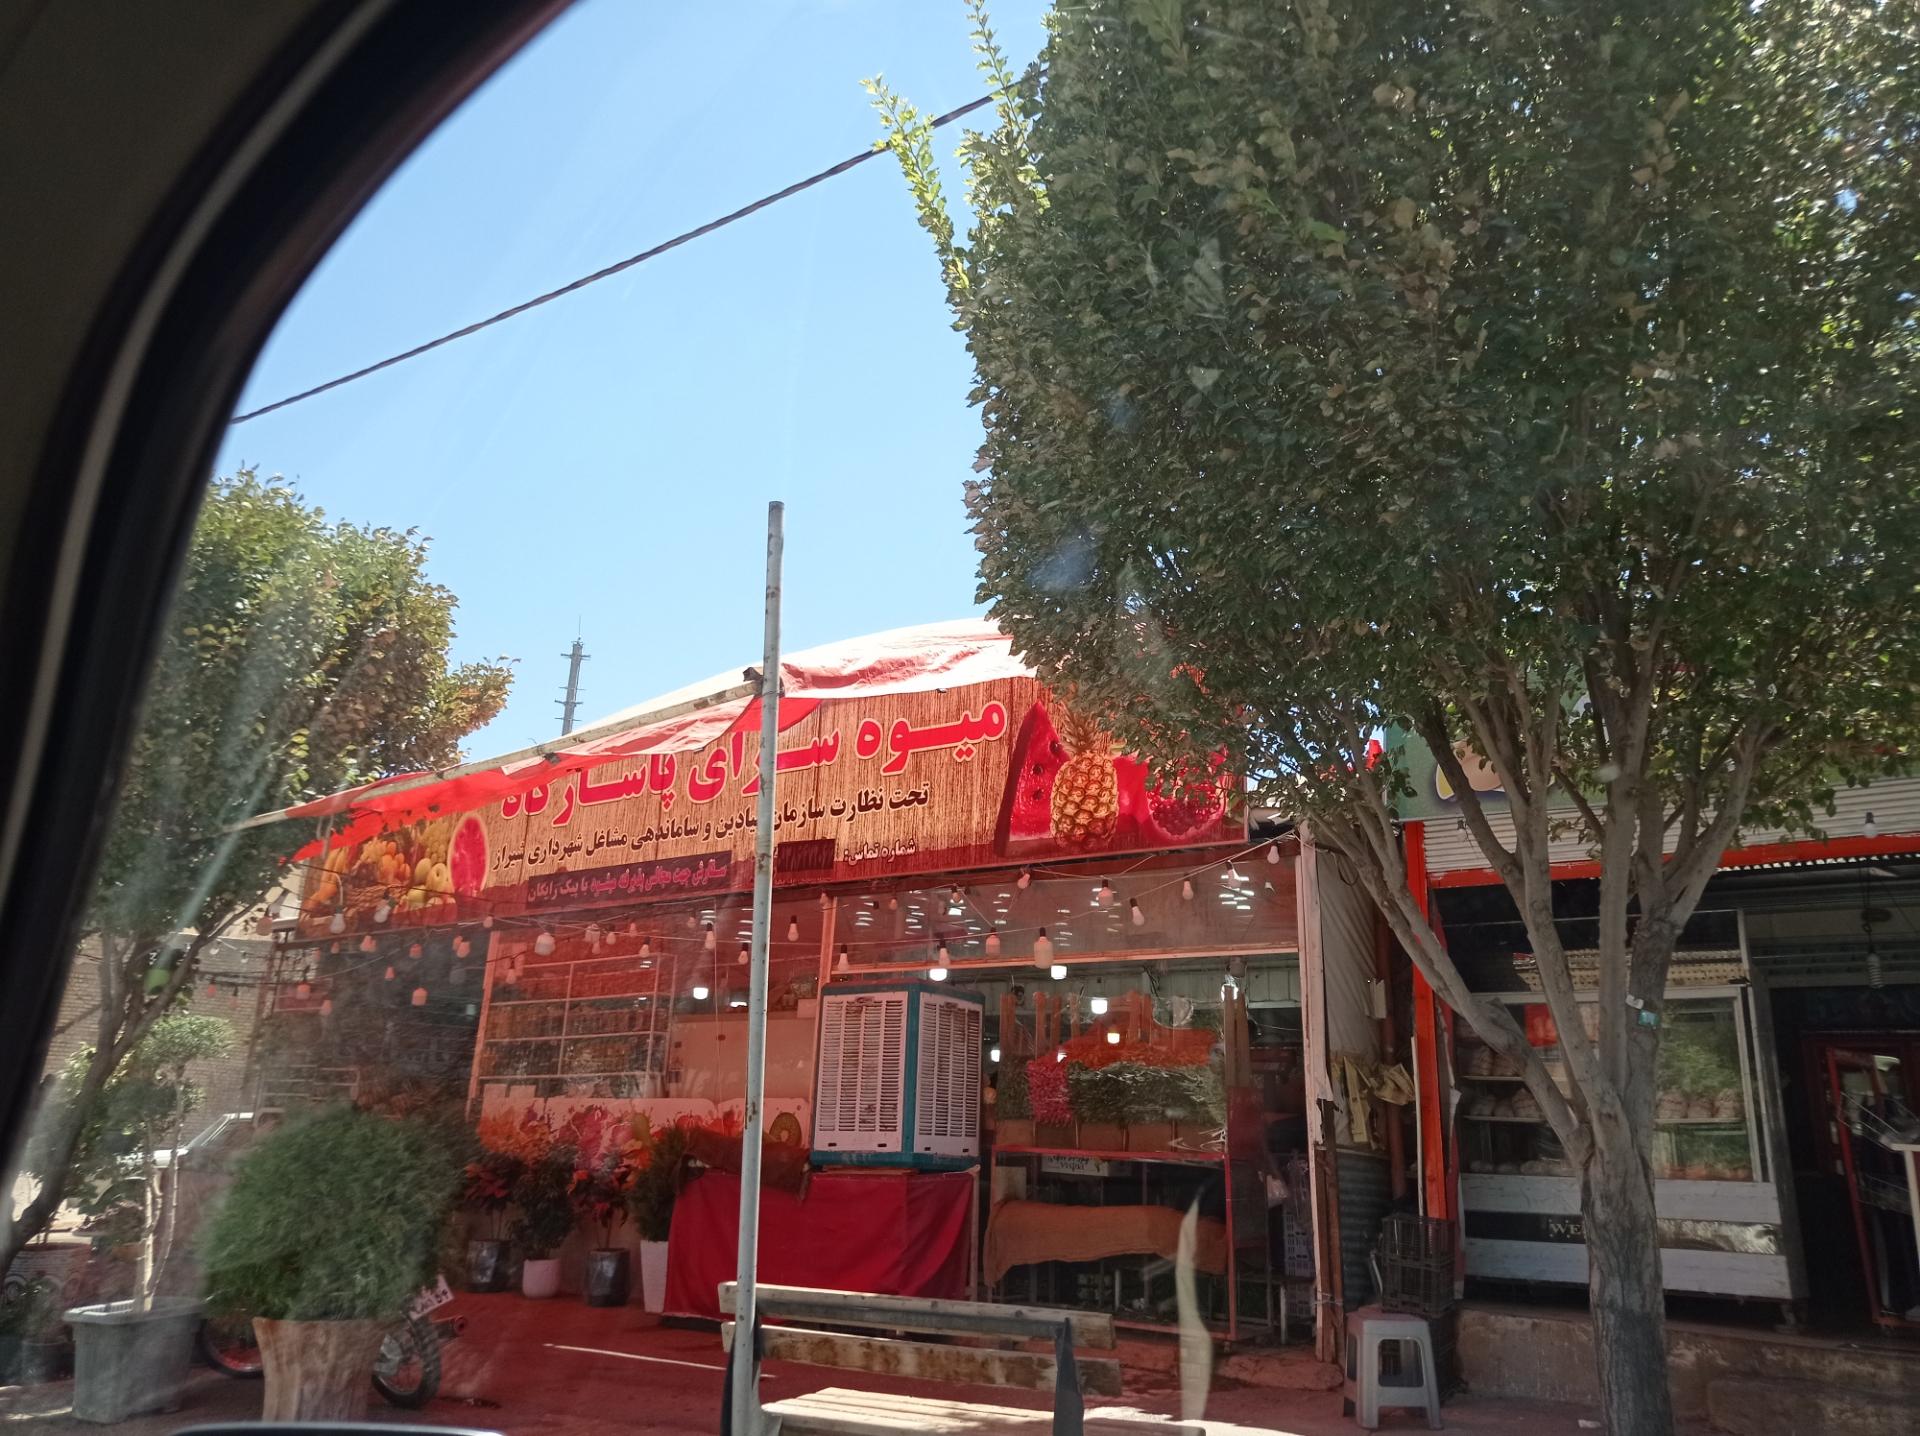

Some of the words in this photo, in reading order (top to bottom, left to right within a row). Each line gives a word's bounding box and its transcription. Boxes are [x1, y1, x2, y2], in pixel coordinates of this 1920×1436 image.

[856, 700, 1007, 777] میوه
[830, 787, 884, 822] نظارت
[889, 781, 929, 810] تحت
[630, 816, 699, 851] ساماندهی
[702, 821, 713, 843] و
[715, 806, 758, 839] یادین
[492, 842, 525, 871] شیراز
[527, 833, 583, 866] شهرداری
[585, 827, 628, 858] مشاغل
[881, 838, 917, 863] شماره
[580, 876, 590, 895] با
